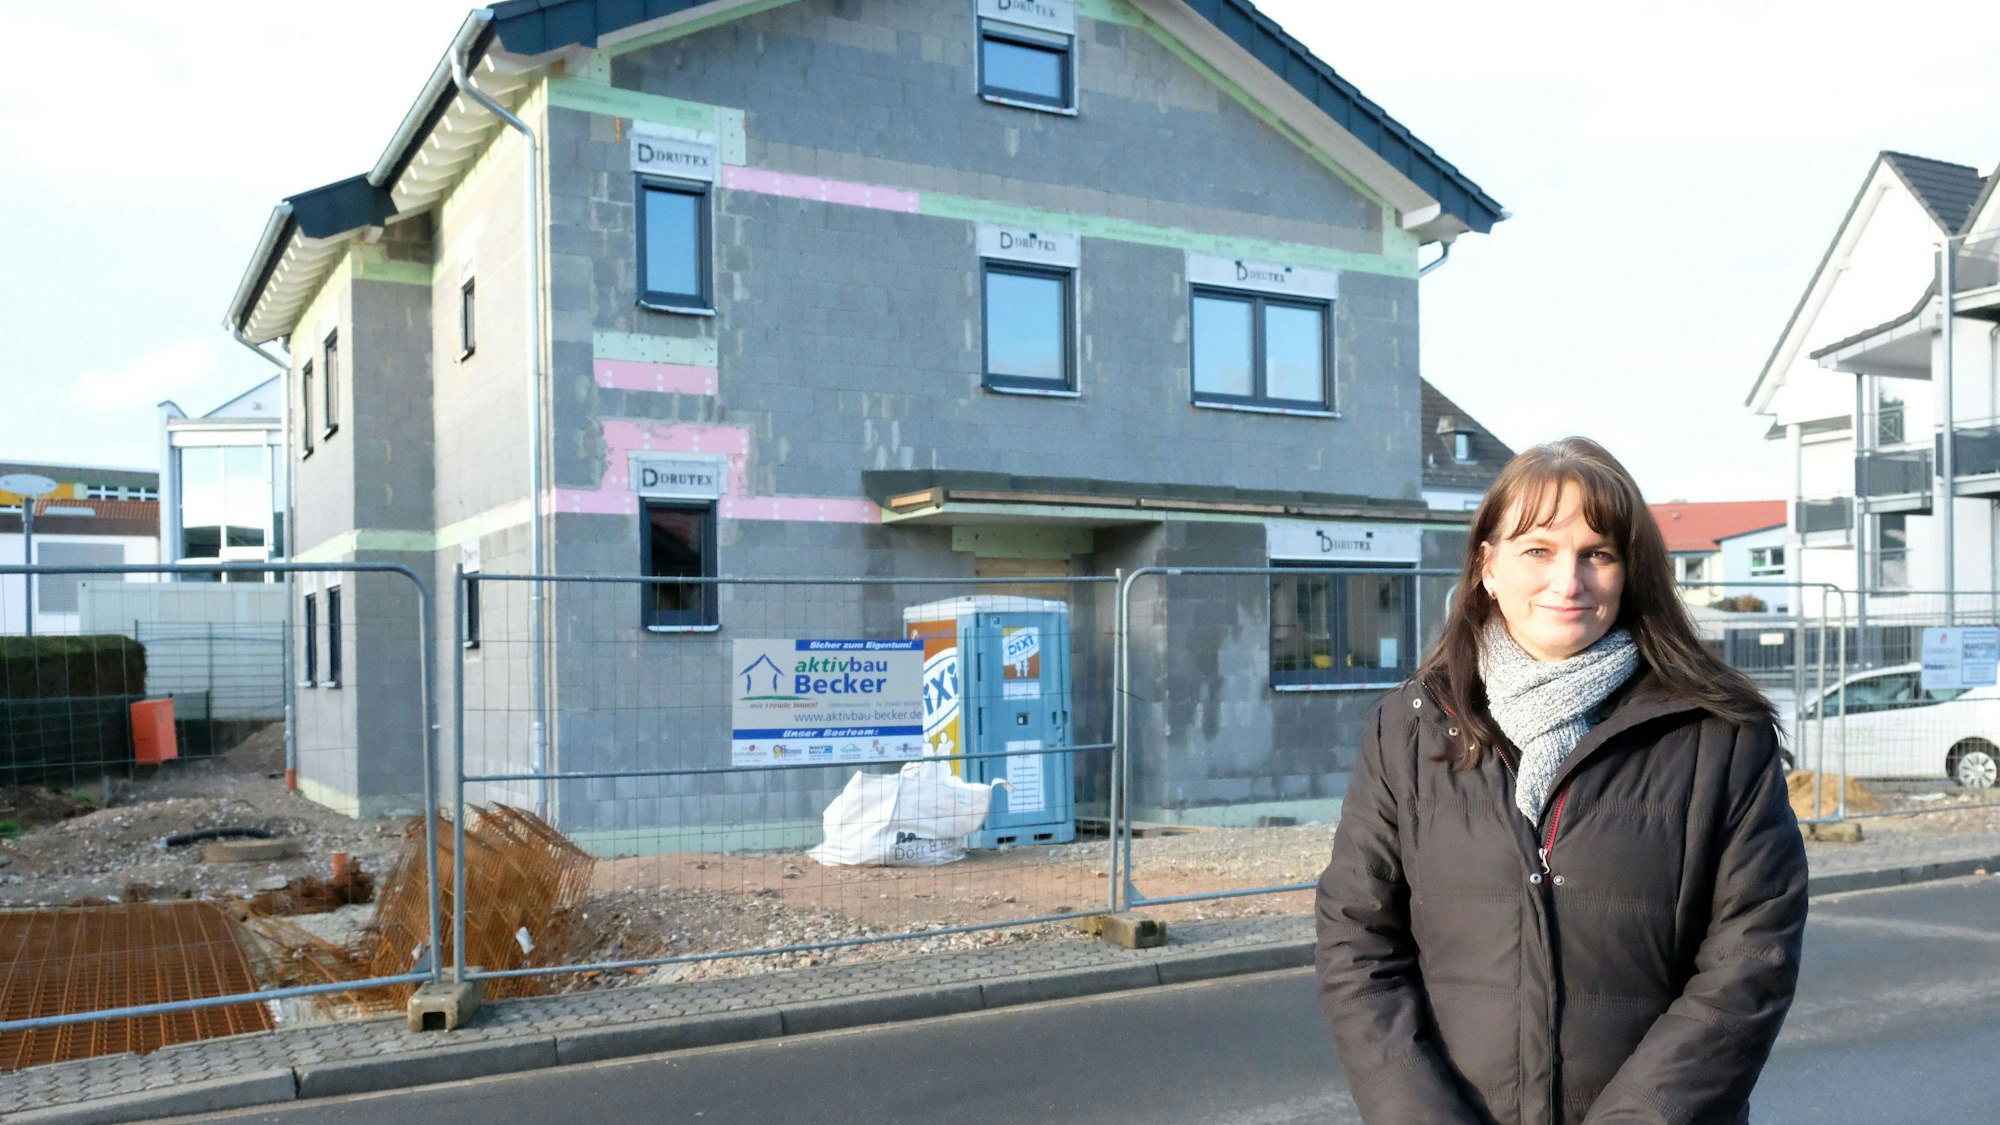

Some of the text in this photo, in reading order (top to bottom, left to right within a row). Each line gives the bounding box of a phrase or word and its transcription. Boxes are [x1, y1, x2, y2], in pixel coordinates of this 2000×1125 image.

[656, 150, 709, 167] DRUTEX
[660, 473, 713, 487] DRUTEX
[809, 641, 913, 650] Sicher zum Eigentum!
[794, 656, 888, 673] aktivbau
[794, 673, 888, 695] Becker
[794, 709, 922, 722] www.aktivbau-becker.de
[782, 728, 880, 738] Unser Bauteam:
